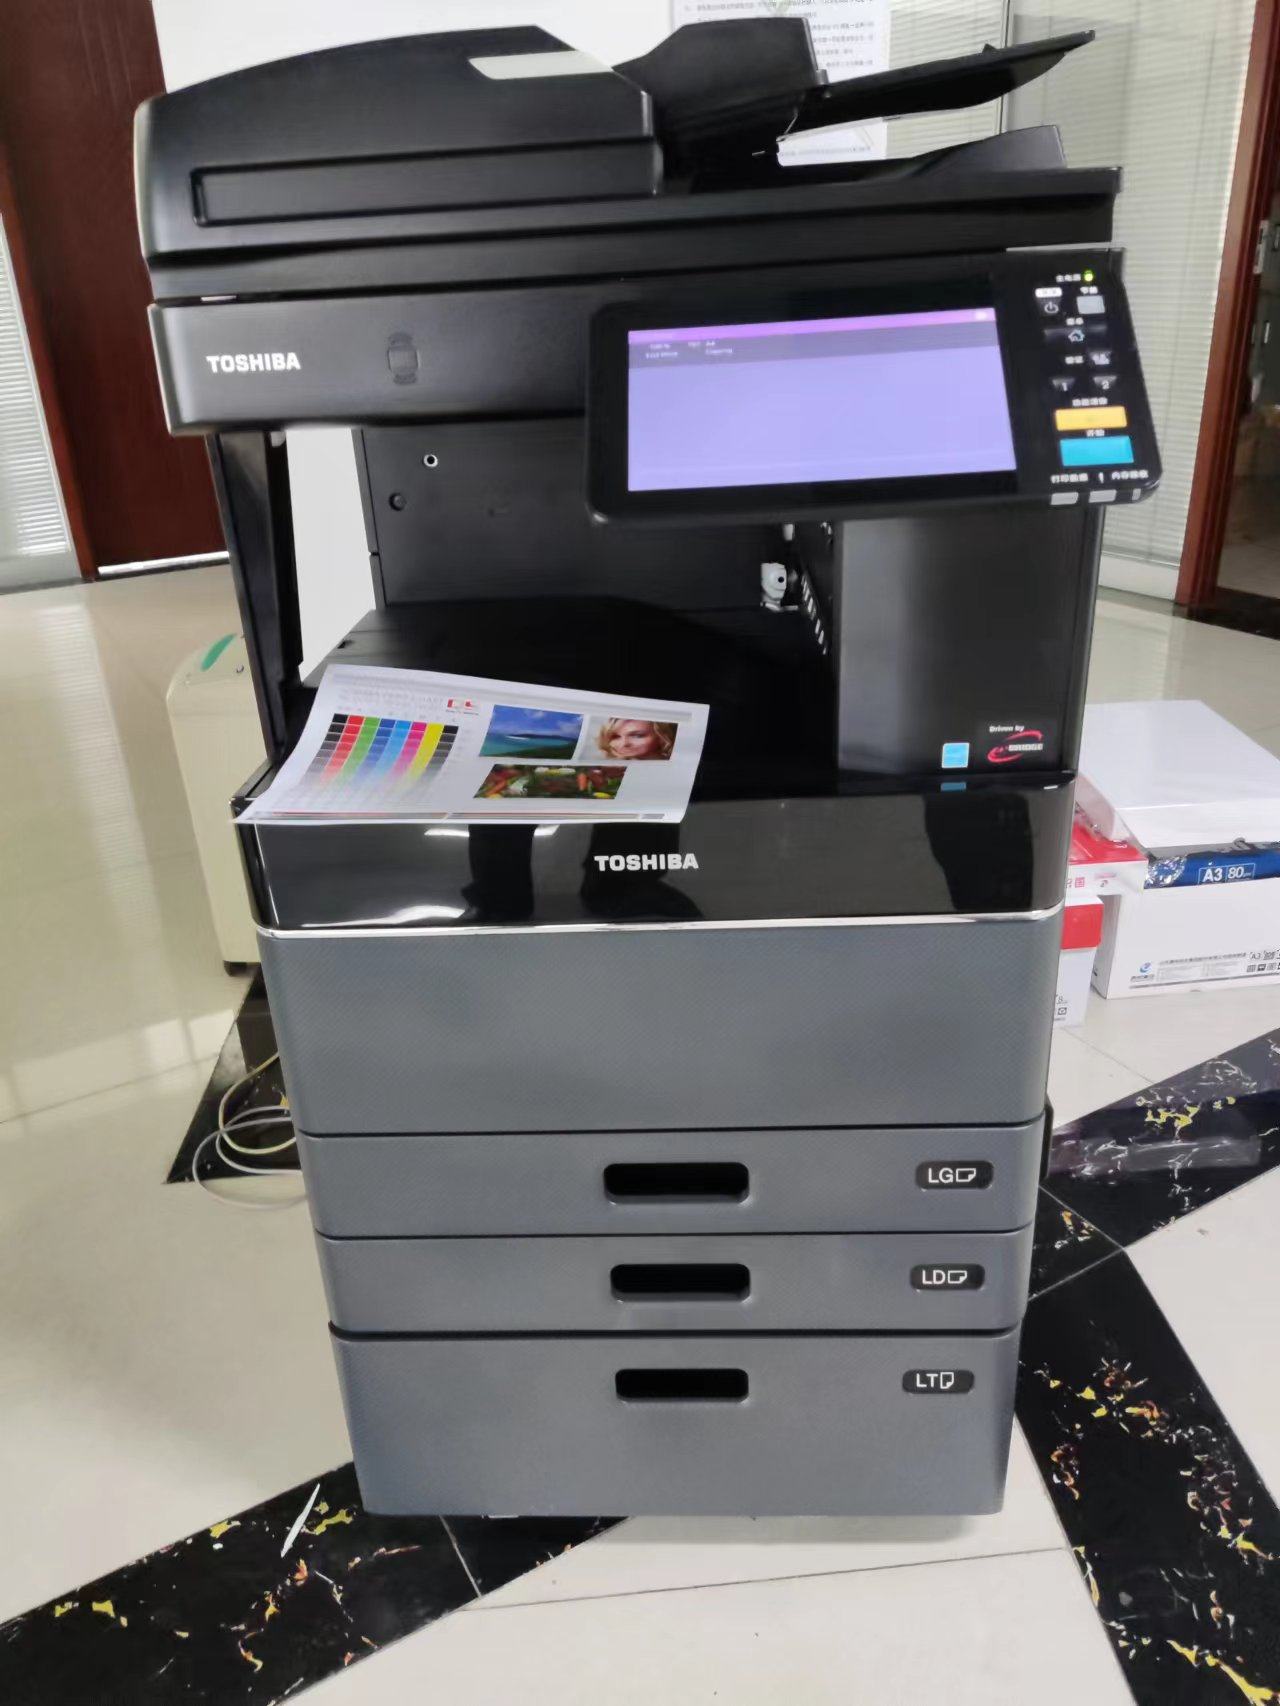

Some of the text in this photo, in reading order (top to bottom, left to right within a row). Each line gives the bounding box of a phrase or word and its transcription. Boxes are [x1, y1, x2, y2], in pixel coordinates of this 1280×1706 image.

[205, 352, 301, 373] TOSHIBA
[989, 725, 1025, 733] Driven by
[594, 853, 699, 871] TOSHIBA
[1202, 868, 1223, 883] A3
[1227, 866, 1244, 879] 80
[928, 1167, 954, 1184] LG
[922, 1269, 946, 1285] LD
[916, 1373, 938, 1388] LT
